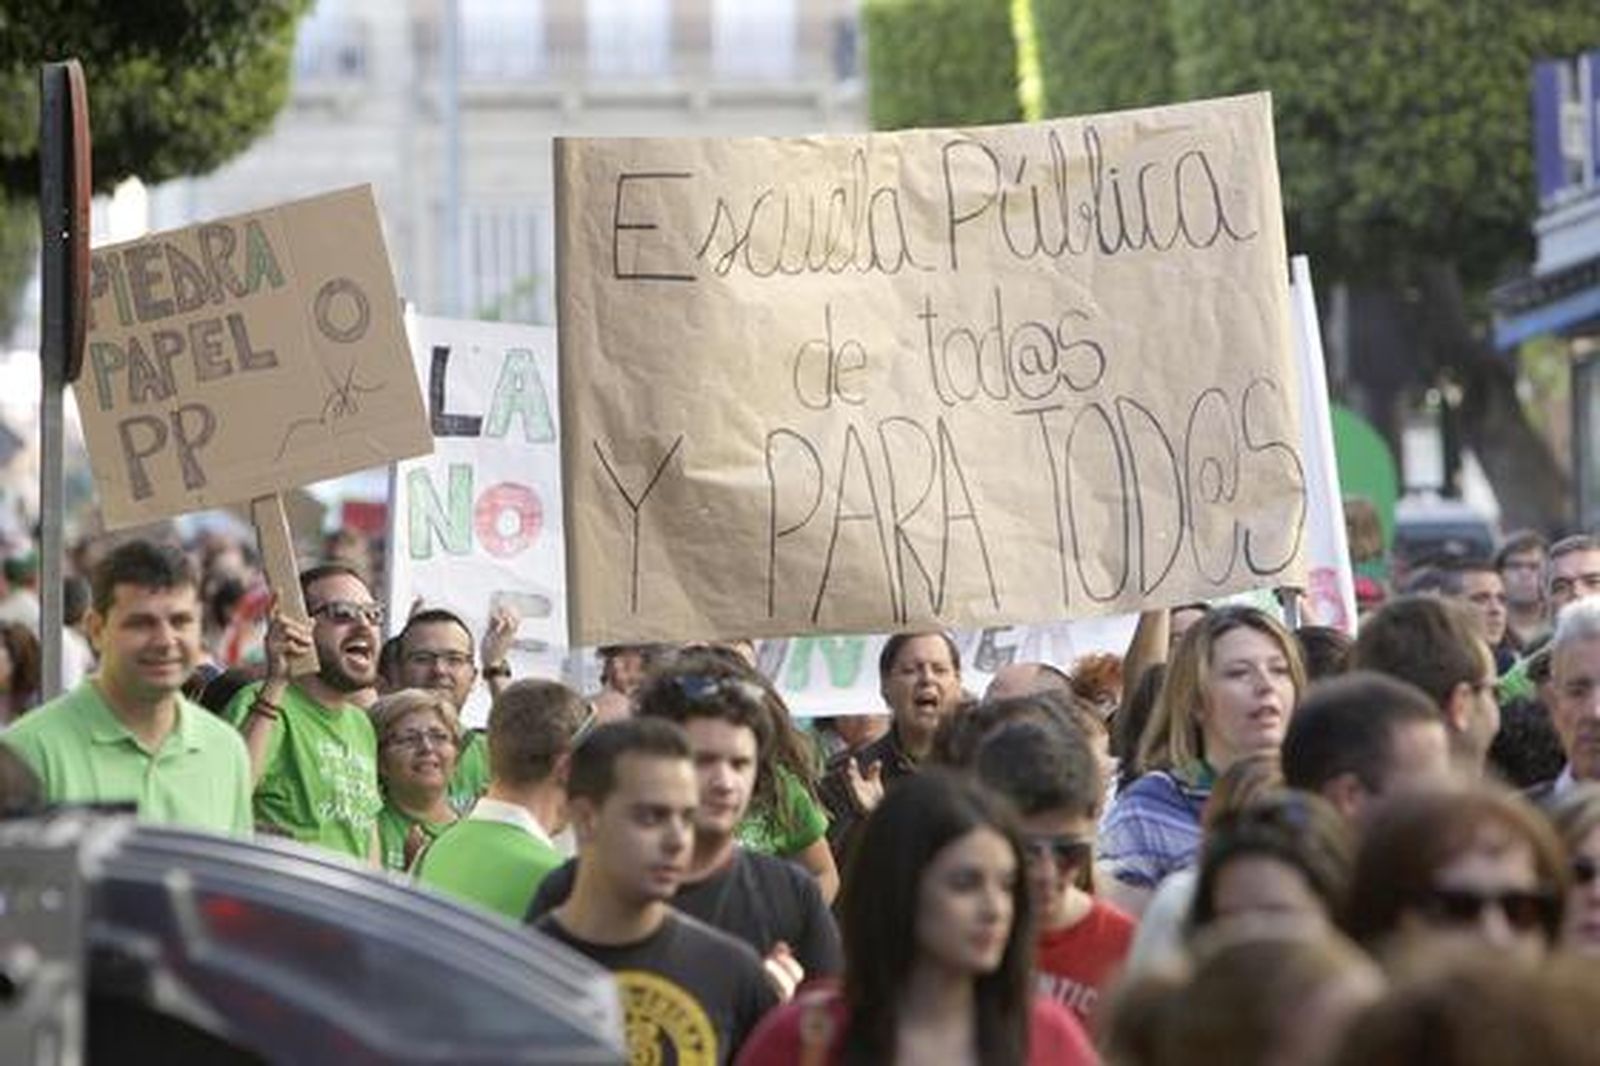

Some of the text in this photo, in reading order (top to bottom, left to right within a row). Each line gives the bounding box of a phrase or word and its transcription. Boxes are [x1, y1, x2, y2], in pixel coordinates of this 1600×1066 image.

[613, 125, 1258, 281] Escuela Pública
[89, 312, 279, 412] PAPEL
[429, 345, 556, 443] LA
[794, 285, 1107, 410] de tod@s
[118, 403, 217, 502] PP
[593, 377, 1307, 625] Y PARA TOD@S
[407, 463, 545, 560] NO
